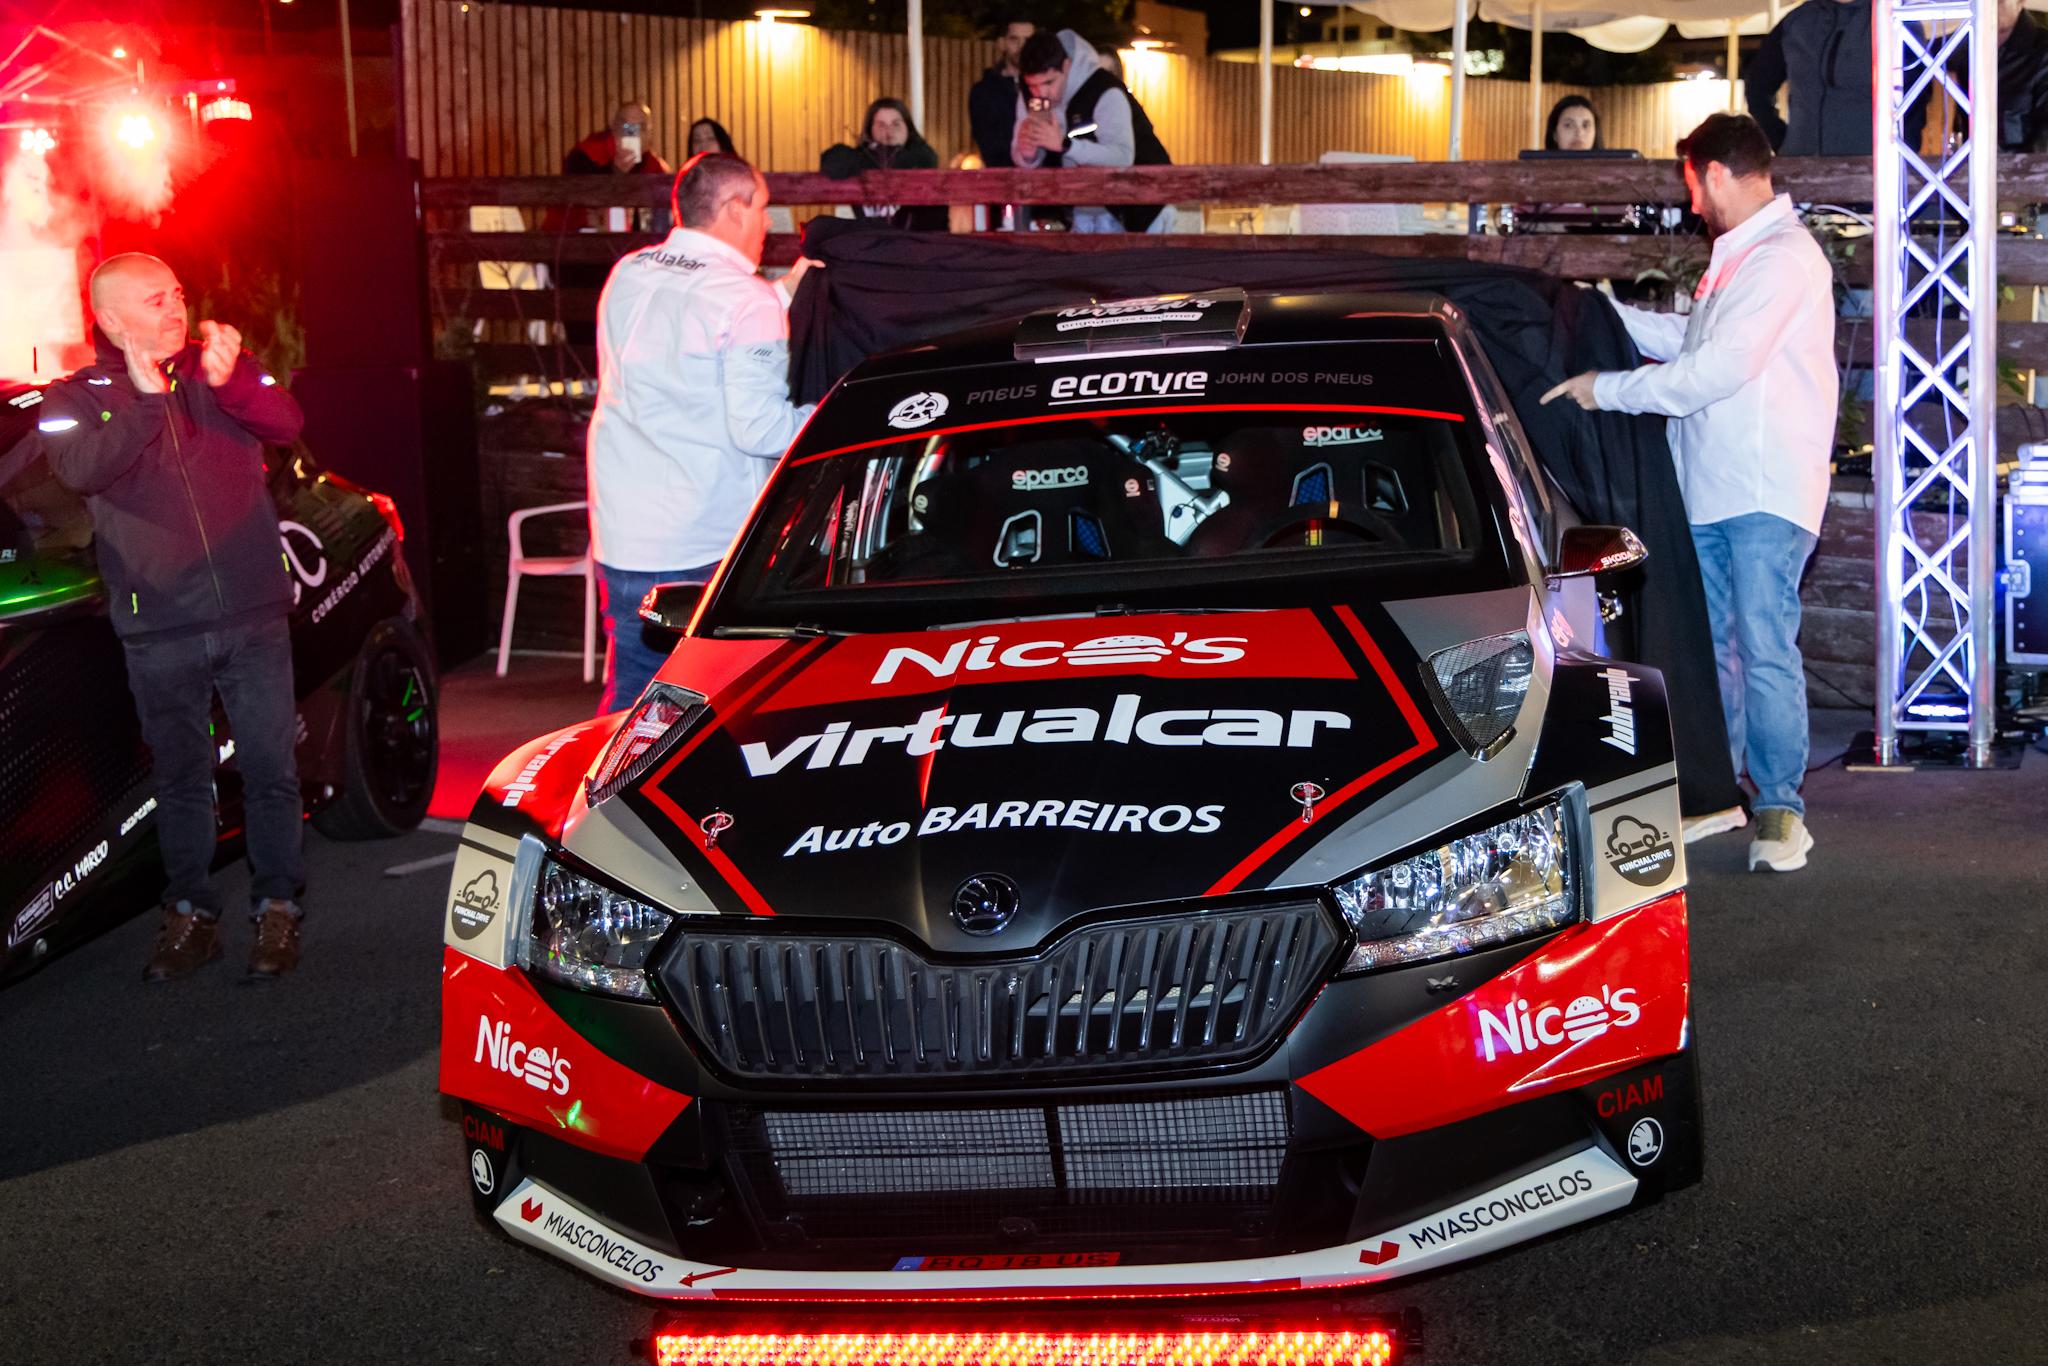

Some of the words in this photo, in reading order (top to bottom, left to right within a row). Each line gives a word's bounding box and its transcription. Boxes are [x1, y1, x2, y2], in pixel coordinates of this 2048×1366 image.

[1215, 372, 1265, 384] JOHN
[1271, 372, 1309, 384] DOS
[1314, 373, 1374, 385] PNEUS
[1012, 466, 1089, 490] sparco
[740, 693, 1352, 777] virtualcar
[783, 818, 916, 858] Auto
[917, 799, 1226, 837] BARREIROS
[75, 840, 109, 881] MARCO
[1619, 854, 1652, 873] FUNCHAL
[1651, 849, 1673, 862] DRIVE
[1597, 1075, 1664, 1118] CIAM
[464, 1115, 505, 1151] CIAM
[1409, 1170, 1592, 1249] MVASCONCELOS
[544, 1211, 664, 1282] MVASCONCELOS
[1002, 1255, 1042, 1268] 18
